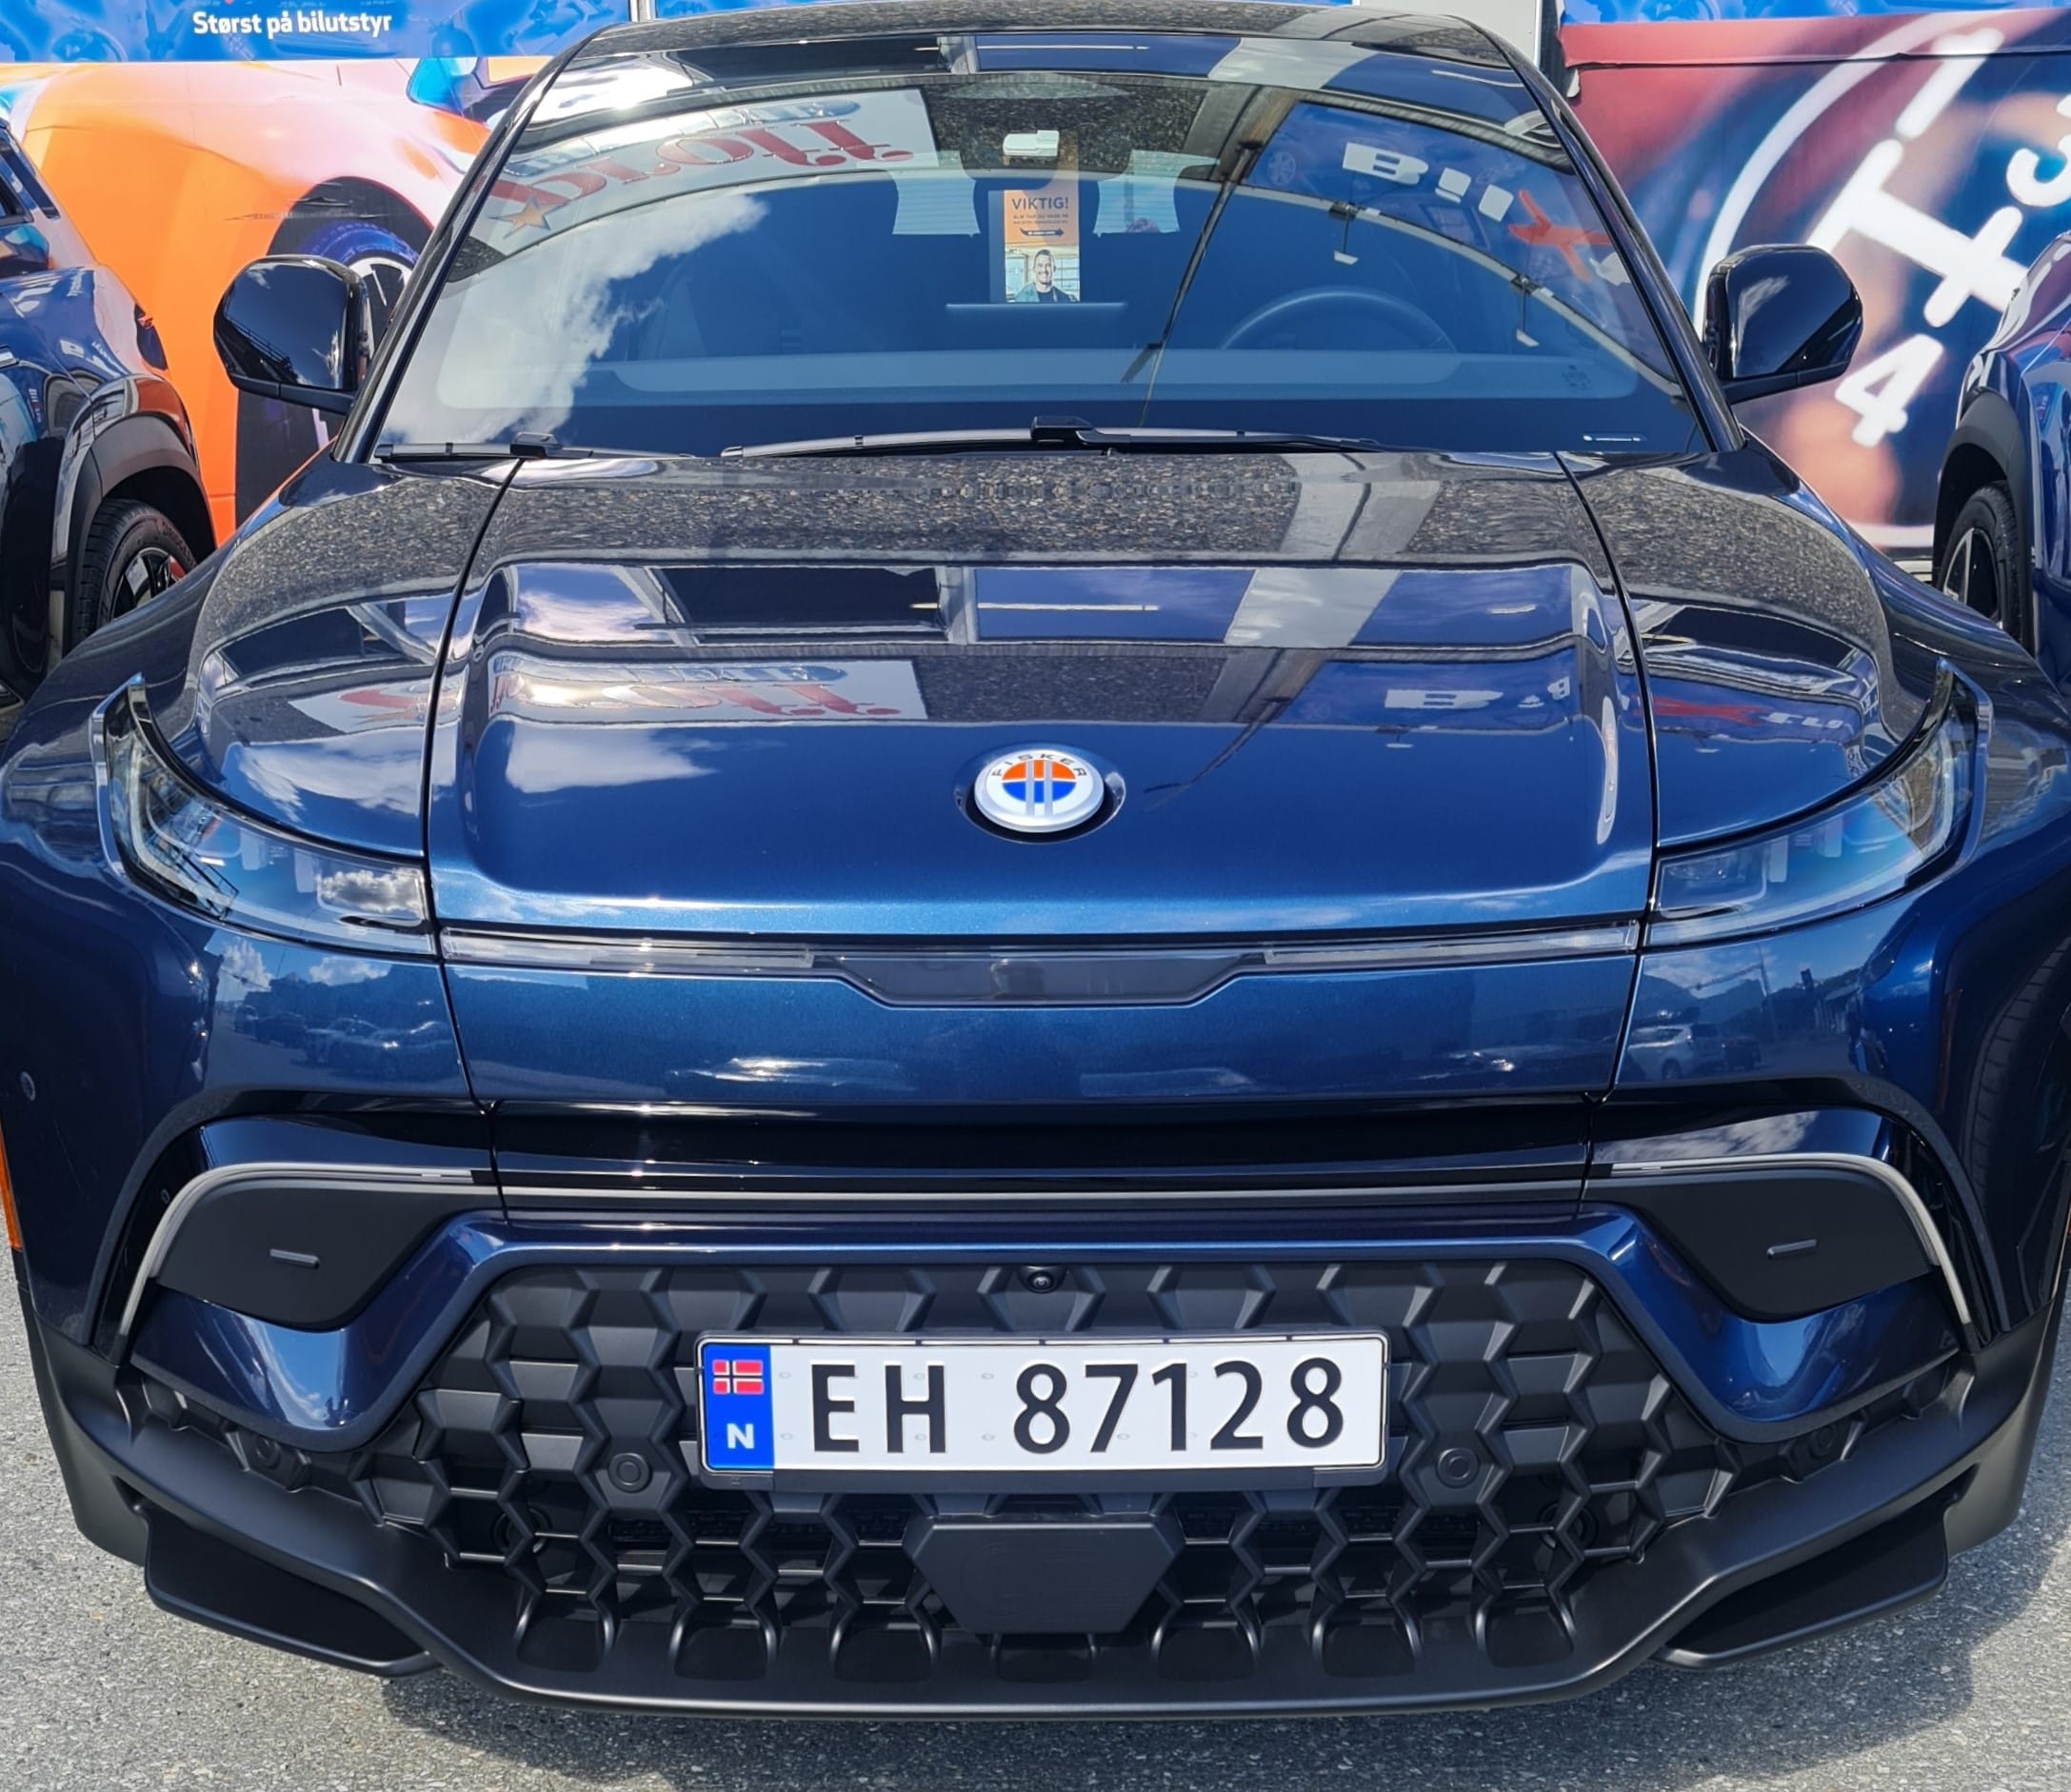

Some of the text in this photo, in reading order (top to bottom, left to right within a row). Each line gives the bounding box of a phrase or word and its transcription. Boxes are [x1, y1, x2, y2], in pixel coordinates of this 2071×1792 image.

[192, 10, 392, 39] Størst på bilutstyr
[1011, 196, 1069, 210] VIKTIG!
[1835, 333, 1945, 448] 4
[991, 753, 1087, 777] FISKER
[810, 1357, 1344, 1455] EH 87128
[727, 1423, 755, 1449] N
